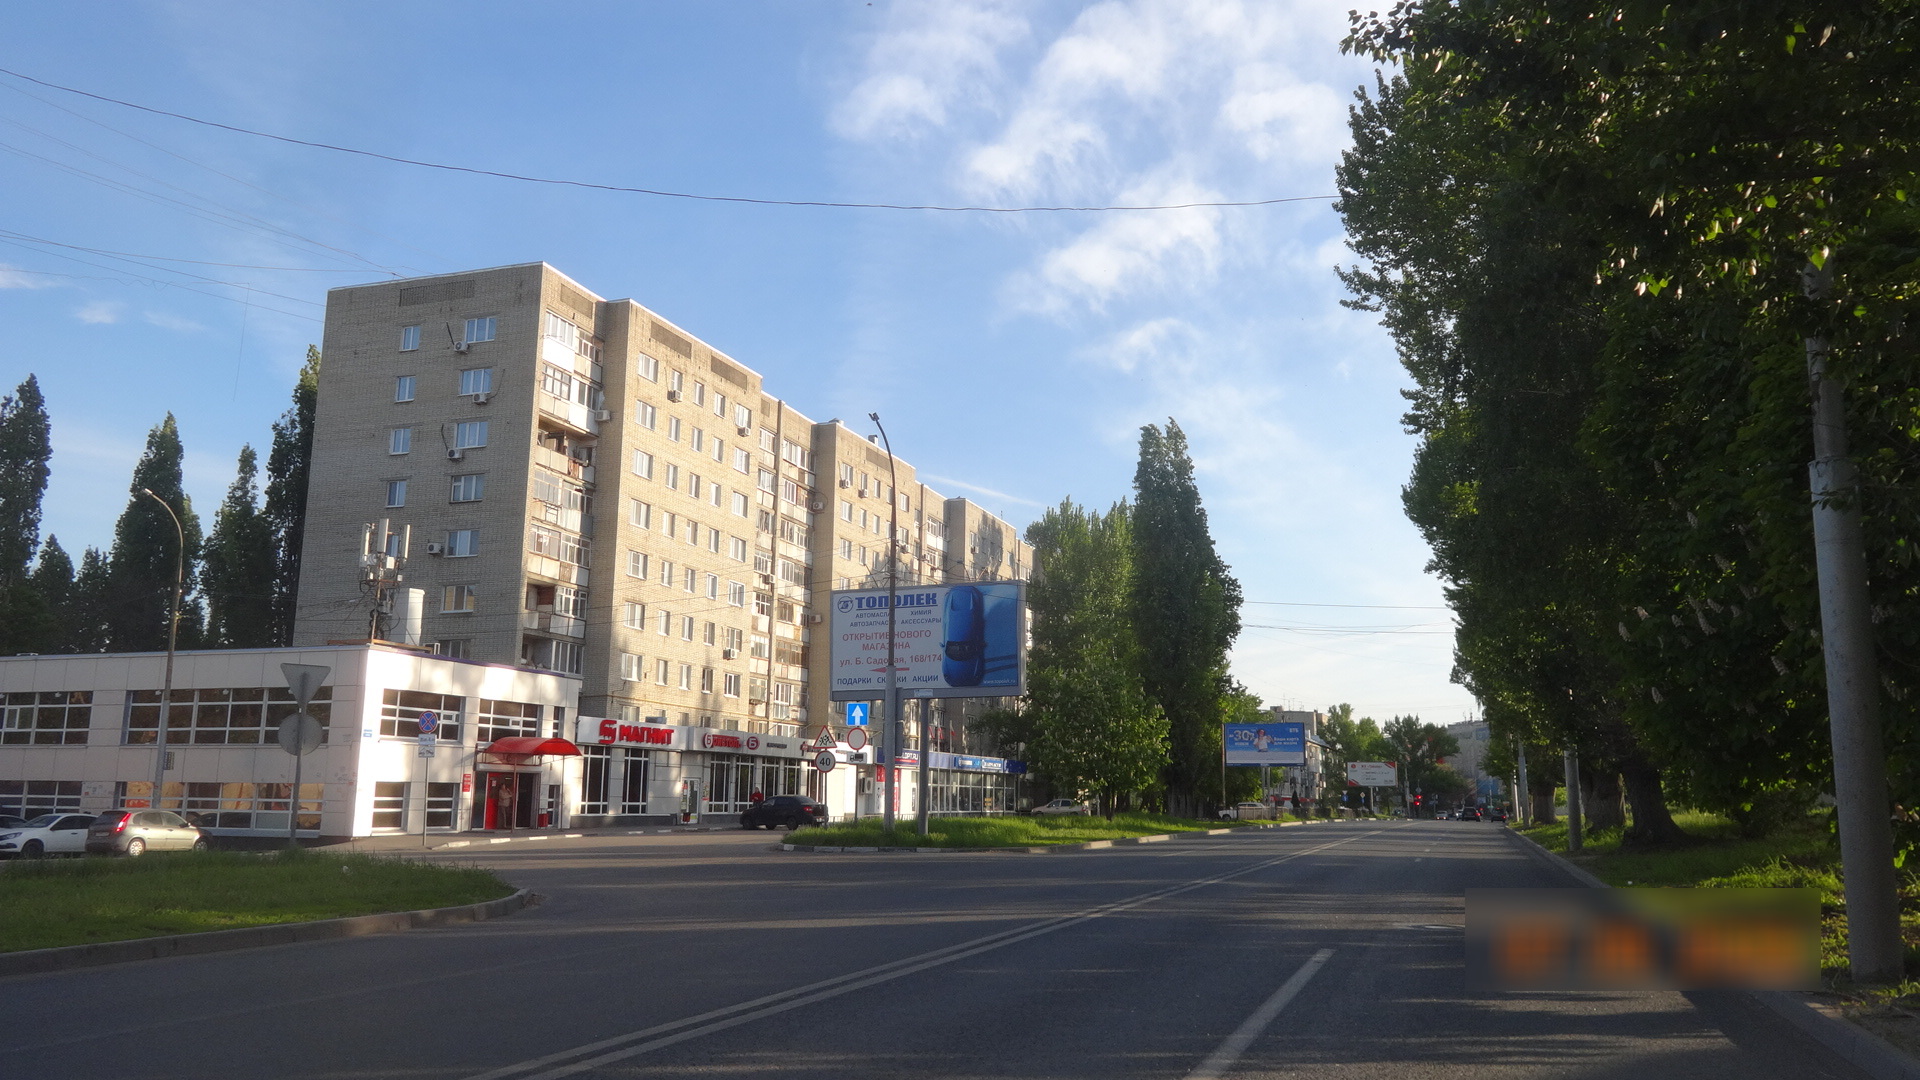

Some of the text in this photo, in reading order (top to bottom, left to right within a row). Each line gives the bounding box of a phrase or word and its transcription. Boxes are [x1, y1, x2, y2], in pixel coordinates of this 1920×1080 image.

[855, 593, 937, 609] ТОПОЛЕК
[850, 617, 942, 627] АВТОЗАПЧАС АКСЕССУАРЫ
[842, 630, 931, 641] ОТКРЫТИЕ НОВОГО
[840, 654, 942, 667] ул. Б. Садоая, 168/174
[837, 675, 939, 686] ПОДАРКИ СККИ АКЦИИ
[619, 724, 675, 745] МАГНИТ
[819, 757, 831, 767] 40
